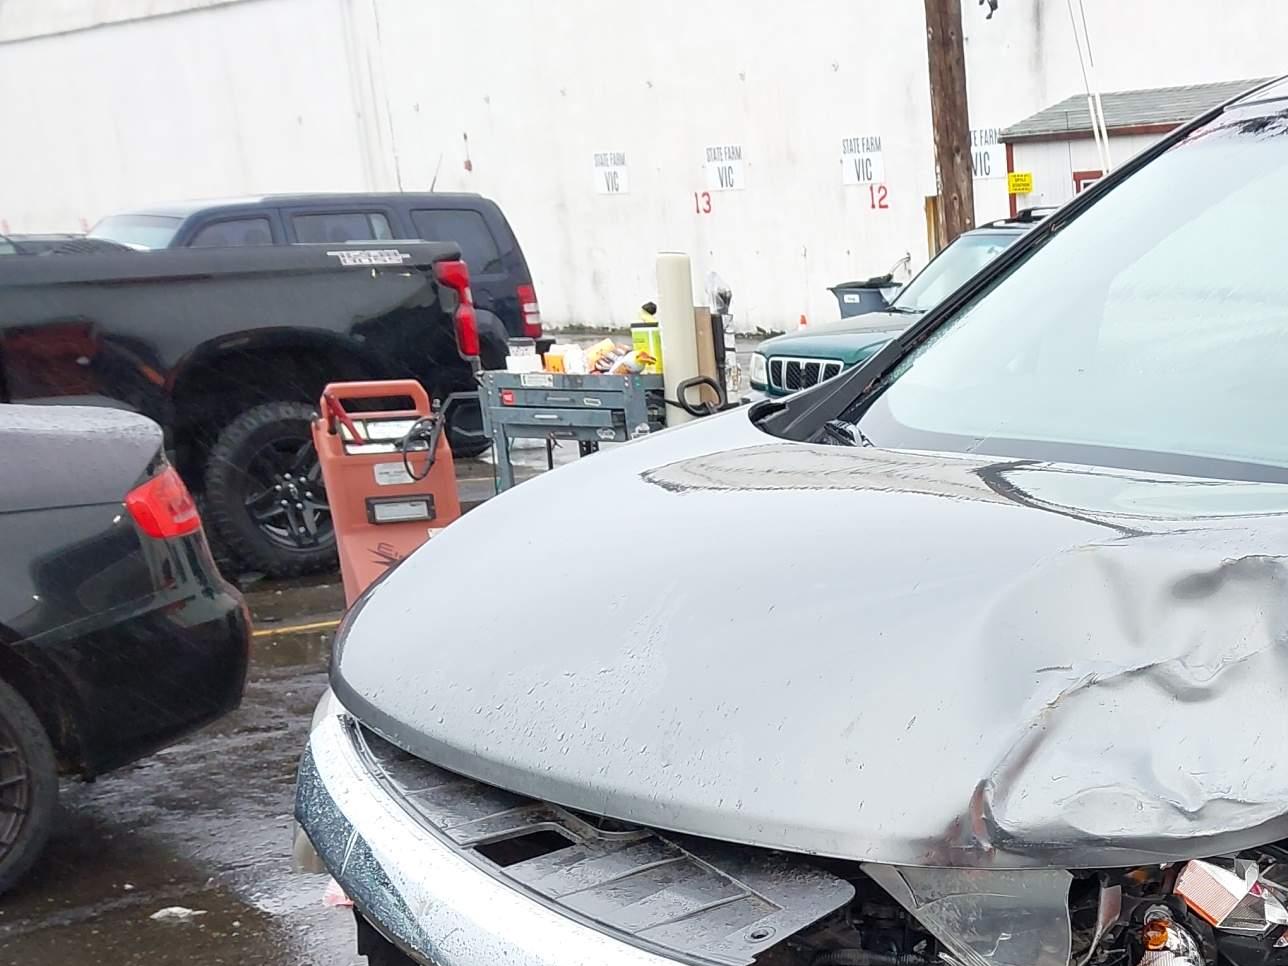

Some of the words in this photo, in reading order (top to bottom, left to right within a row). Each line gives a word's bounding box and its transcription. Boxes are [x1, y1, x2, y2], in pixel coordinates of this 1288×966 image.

[842, 137, 860, 154] STATE
[861, 135, 882, 153] FARM
[979, 128, 1001, 146] FARM
[594, 153, 609, 168] STATE
[610, 152, 626, 167] FARM
[706, 147, 723, 163] STATE
[724, 145, 743, 161] FARM
[971, 151, 991, 177] VIC
[717, 166, 734, 188] VIC
[853, 157, 873, 182] VIC
[604, 171, 620, 193] VIC
[694, 191, 712, 214] 13
[869, 184, 889, 209] 12
